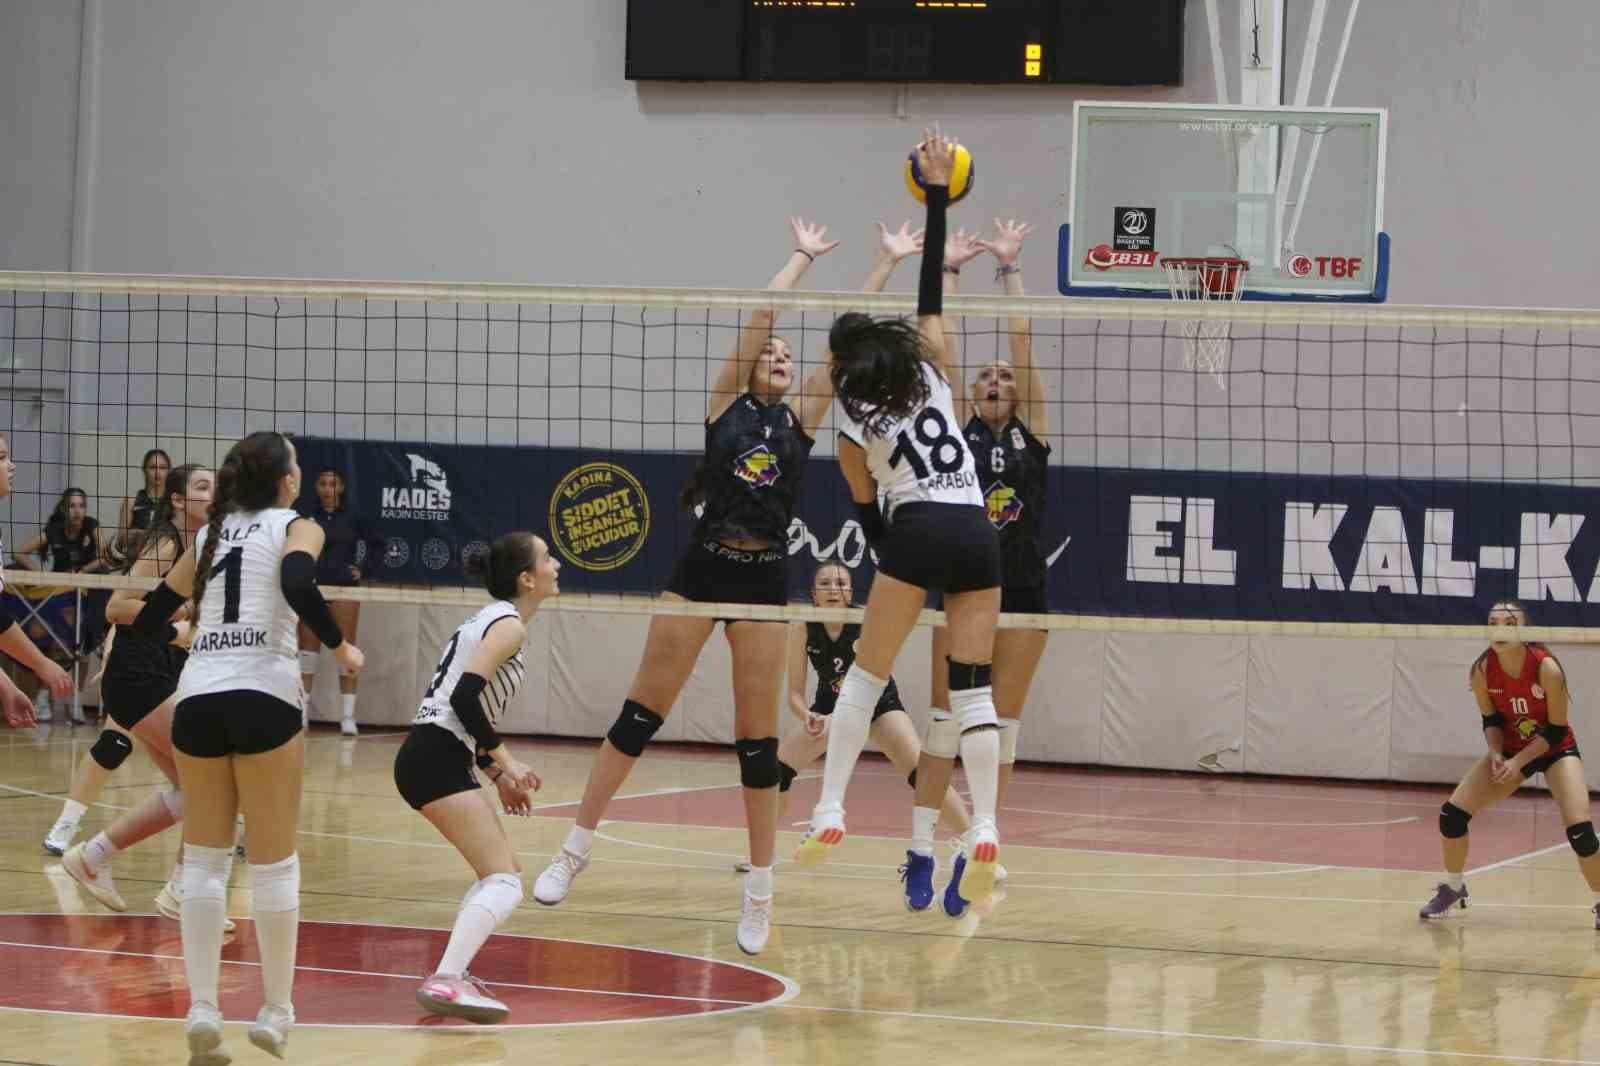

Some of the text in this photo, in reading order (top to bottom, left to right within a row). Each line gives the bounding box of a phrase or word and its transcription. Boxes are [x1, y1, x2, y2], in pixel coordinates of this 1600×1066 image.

[1315, 257, 1361, 278] TBF
[888, 407, 964, 480] 18
[991, 446, 1005, 473] 6
[382, 487, 451, 510] KADES
[413, 510, 449, 520] DESTEK
[1127, 495, 1238, 585] EL
[1282, 501, 1600, 603] KAL-K
[208, 546, 243, 624] 1
[191, 627, 267, 656] KARABÜK
[833, 657, 845, 673] 2
[1509, 697, 1529, 714] 10
